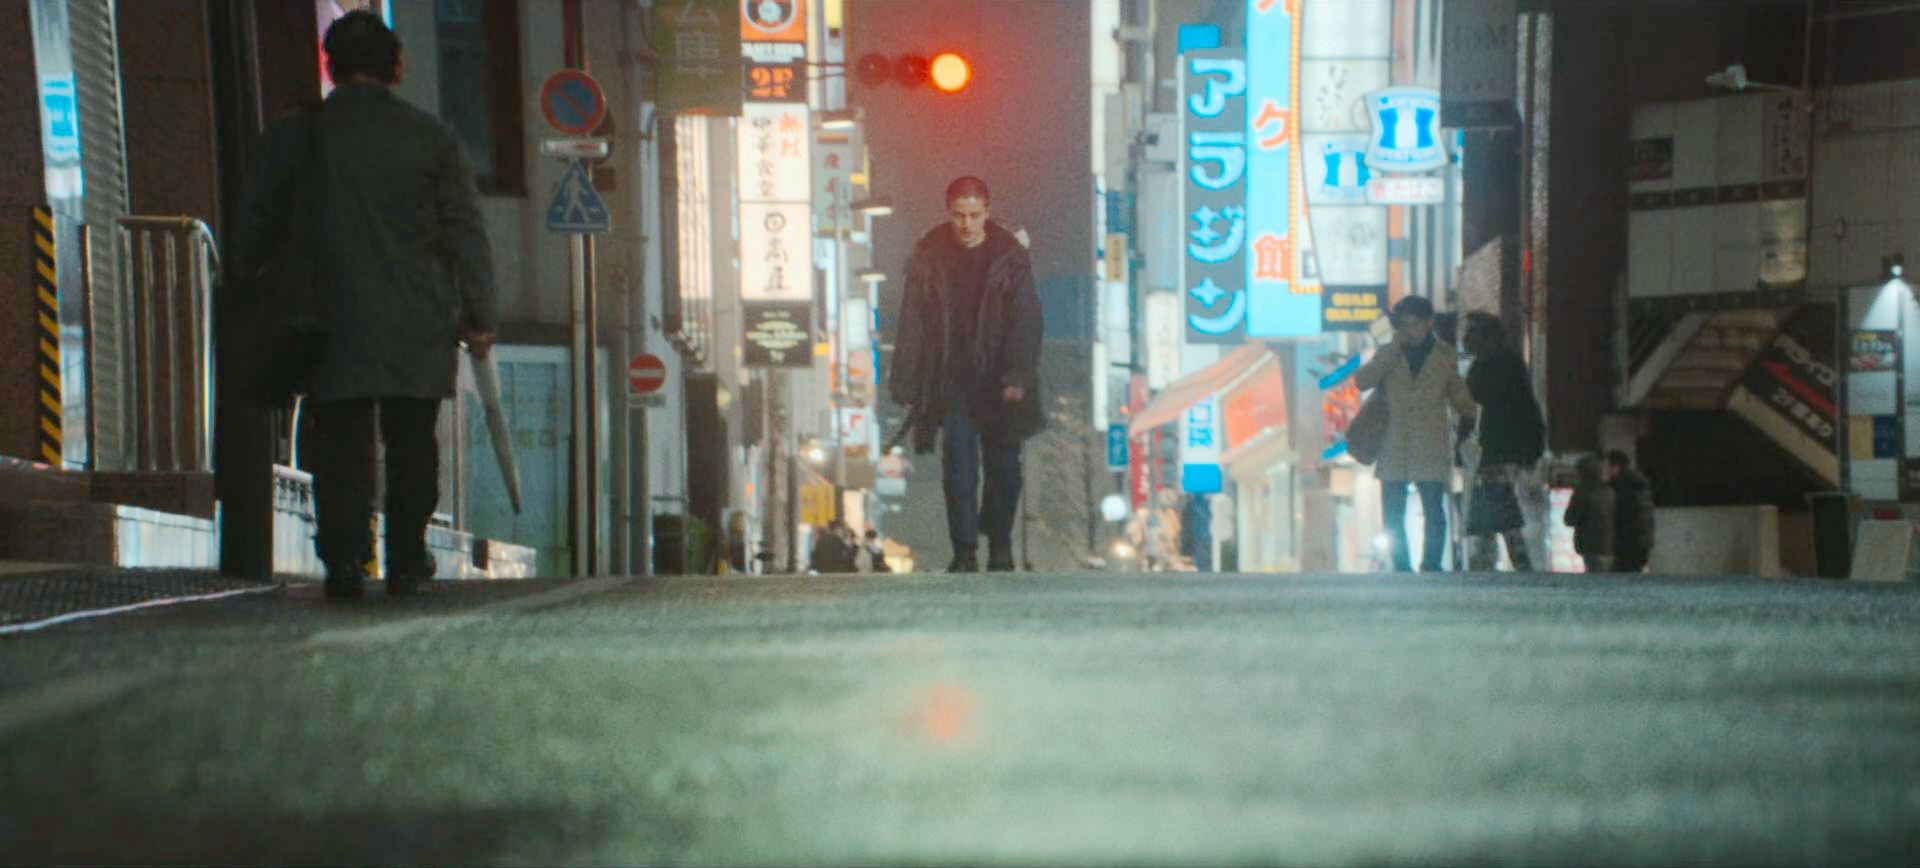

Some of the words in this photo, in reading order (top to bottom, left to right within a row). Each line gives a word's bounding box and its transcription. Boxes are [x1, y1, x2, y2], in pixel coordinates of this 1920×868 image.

[751, 67, 794, 97] 2F
[1187, 57, 1246, 334] アラジン
